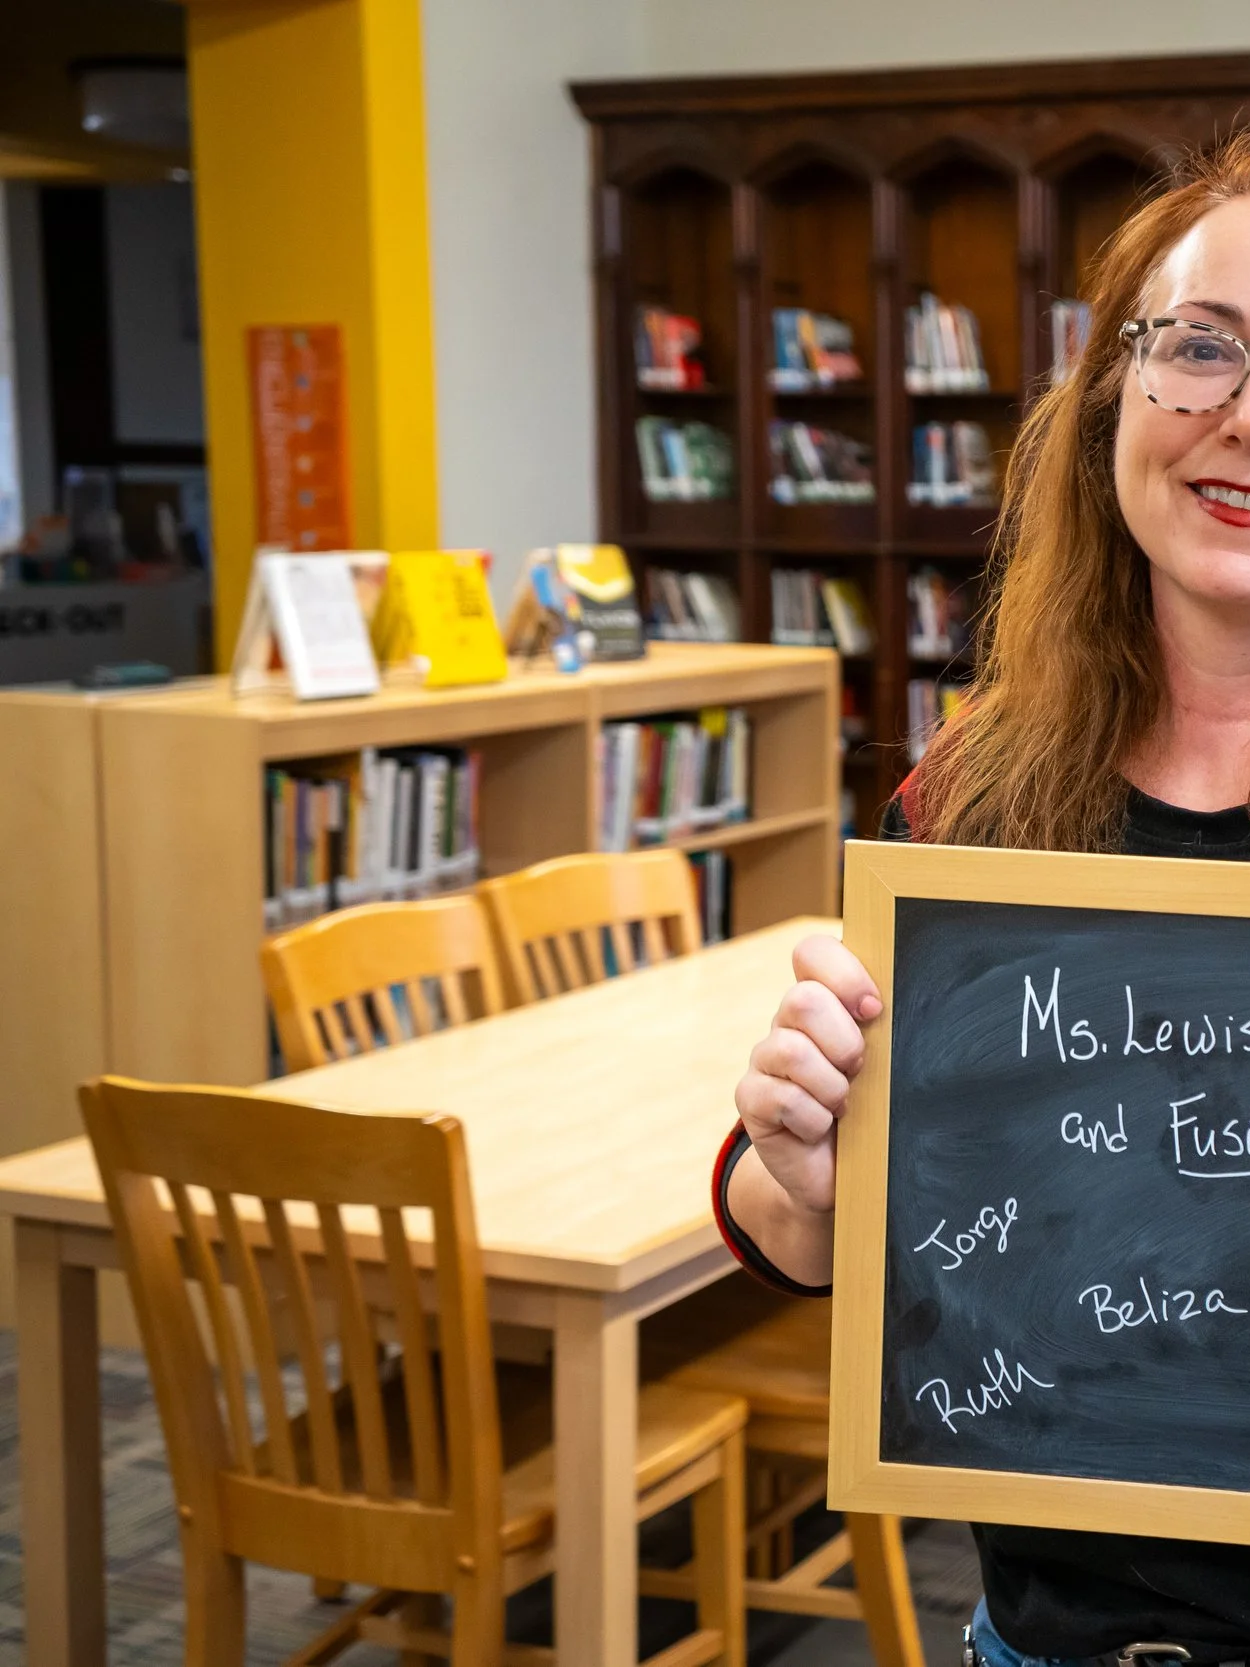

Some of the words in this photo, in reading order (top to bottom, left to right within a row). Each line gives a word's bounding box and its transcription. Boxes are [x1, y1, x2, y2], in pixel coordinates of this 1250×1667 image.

[1022, 967, 1107, 1062] Ms.
[1061, 1104, 1127, 1153] and
[914, 1198, 1017, 1270] Jorge
[1079, 1277, 1248, 1333] Beliza
[916, 1348, 1054, 1433] Ruth
